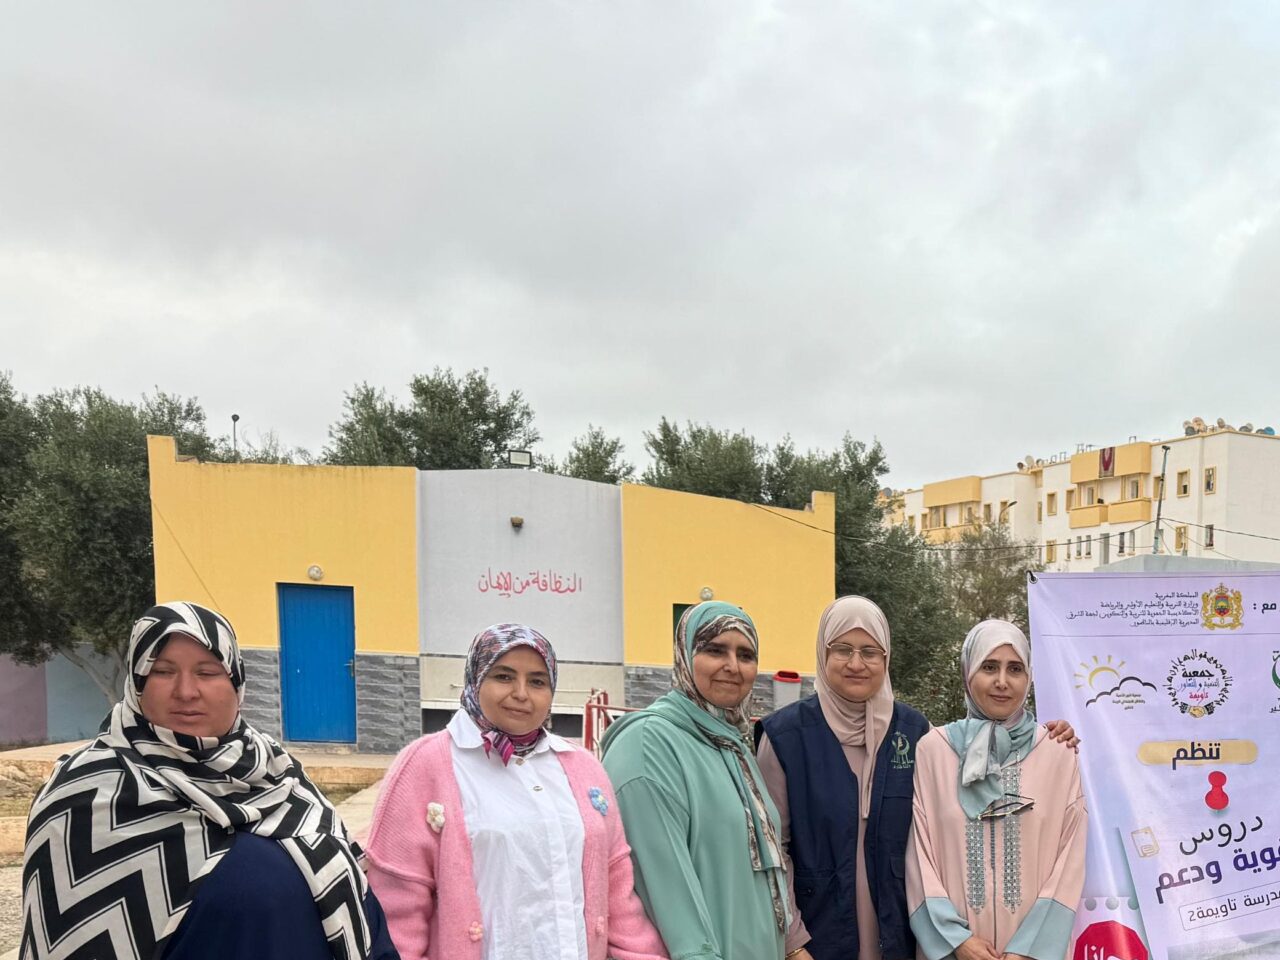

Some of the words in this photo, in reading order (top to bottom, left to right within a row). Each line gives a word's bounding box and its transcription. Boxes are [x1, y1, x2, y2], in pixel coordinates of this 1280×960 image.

[513, 576, 530, 594] من
[529, 569, 582, 593] النظافة
[1261, 603, 1277, 614] مع
[1181, 668, 1215, 681] جمعية
[1171, 742, 1221, 770] تنظم
[1179, 814, 1264, 856] دروس
[1154, 859, 1223, 904] ودعم
